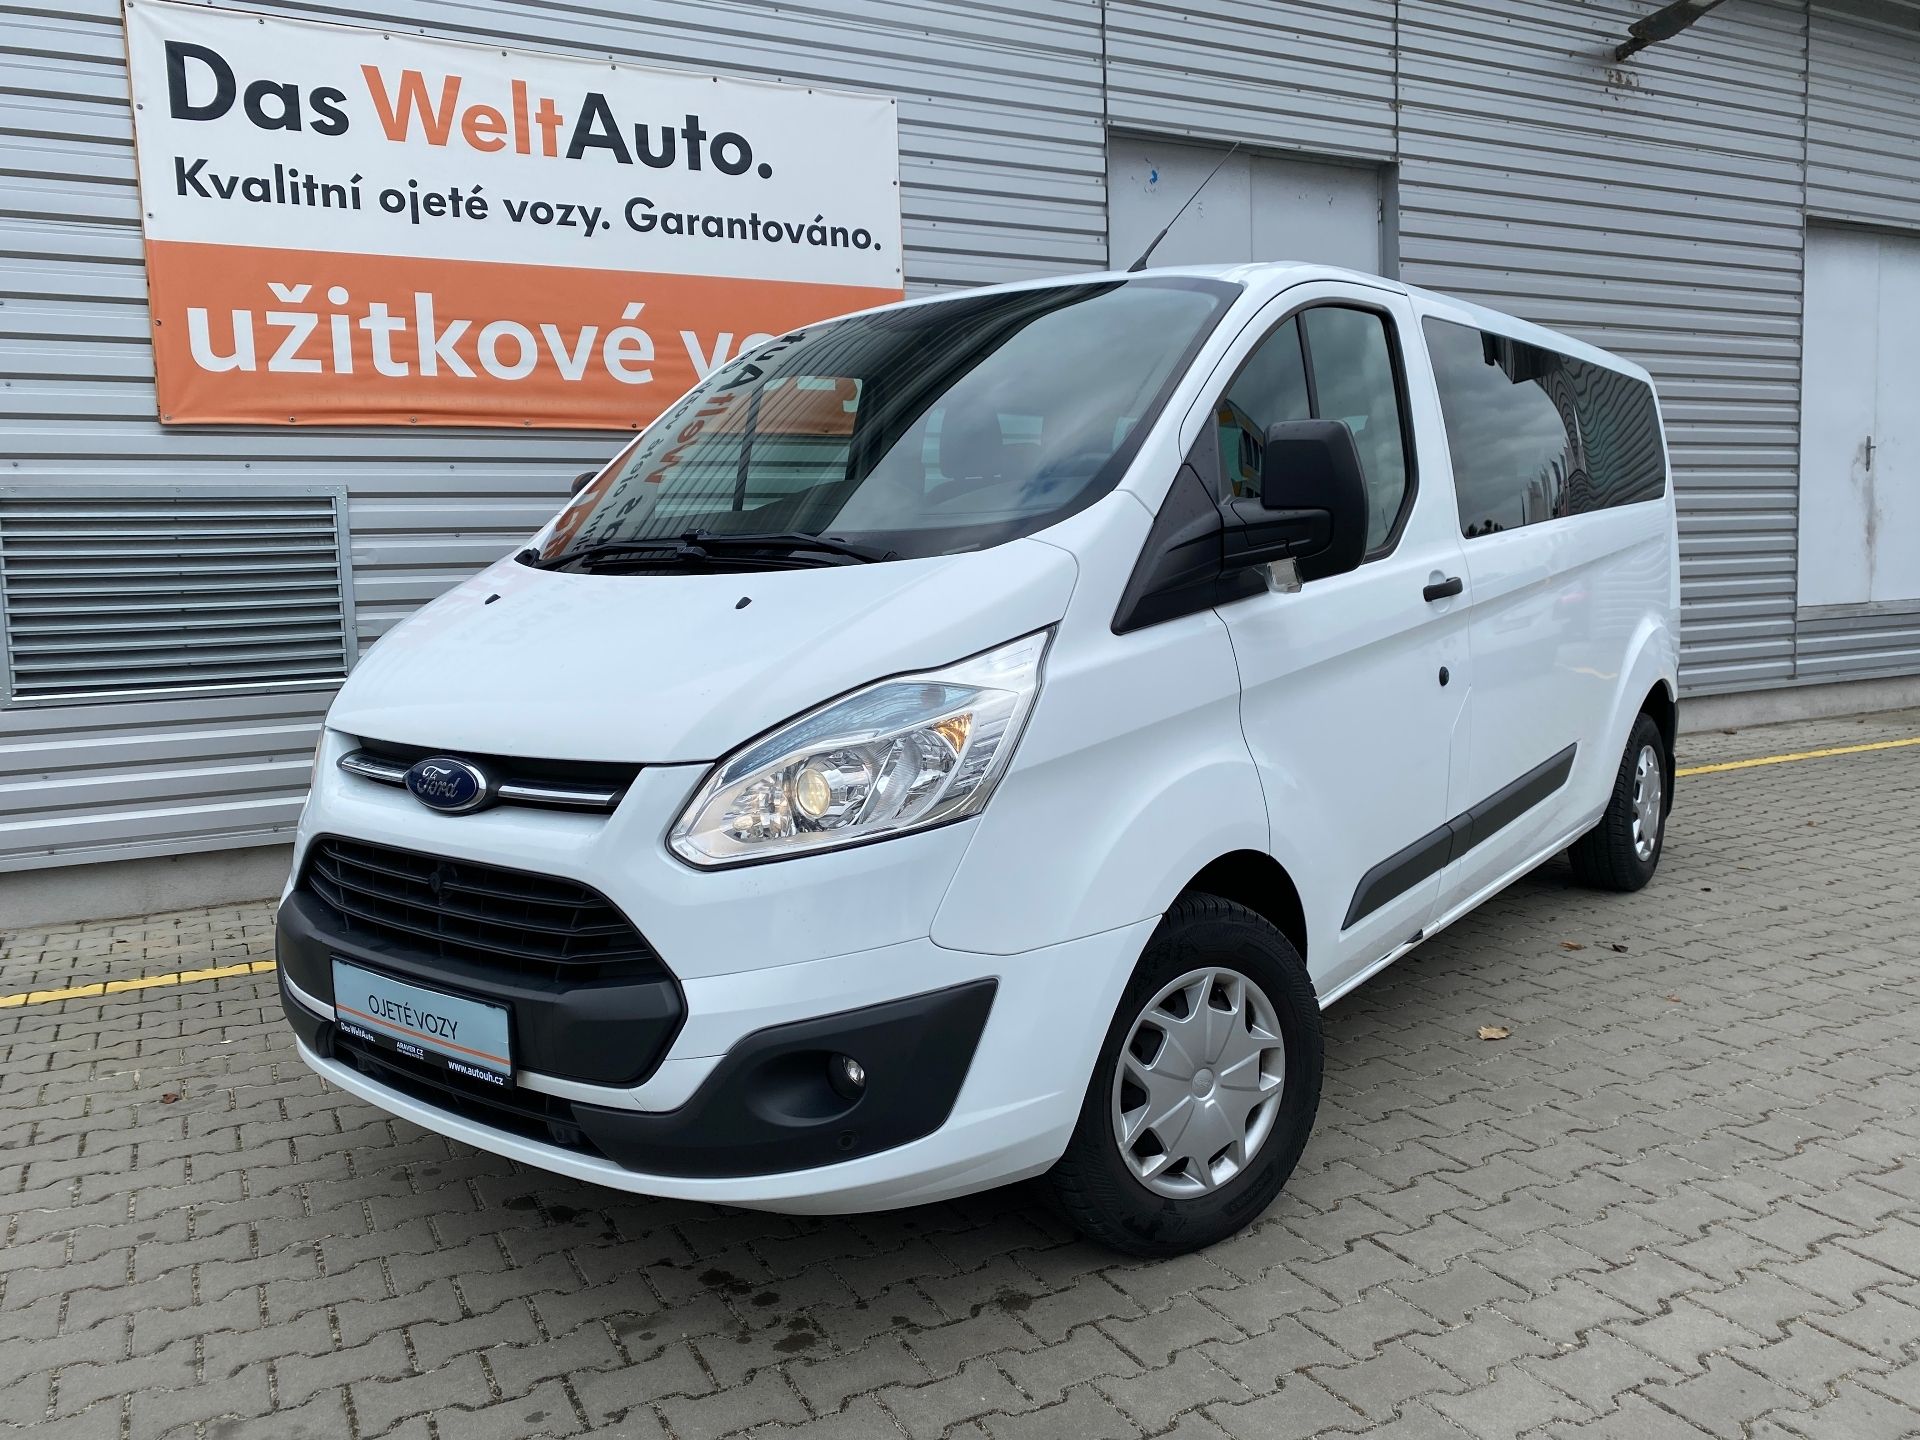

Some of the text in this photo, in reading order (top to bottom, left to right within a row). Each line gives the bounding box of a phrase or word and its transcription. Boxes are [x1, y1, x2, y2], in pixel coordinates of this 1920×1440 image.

[164, 39, 773, 180] Das WeltAuto.
[174, 156, 883, 251] Kvalitní ojeté vozy. Garantováno.
[187, 282, 655, 385] užitkové
[416, 765, 461, 798] Ford
[368, 994, 459, 1041] OJETÉ VOZY
[447, 1060, 504, 1086] www.autouh.cz
